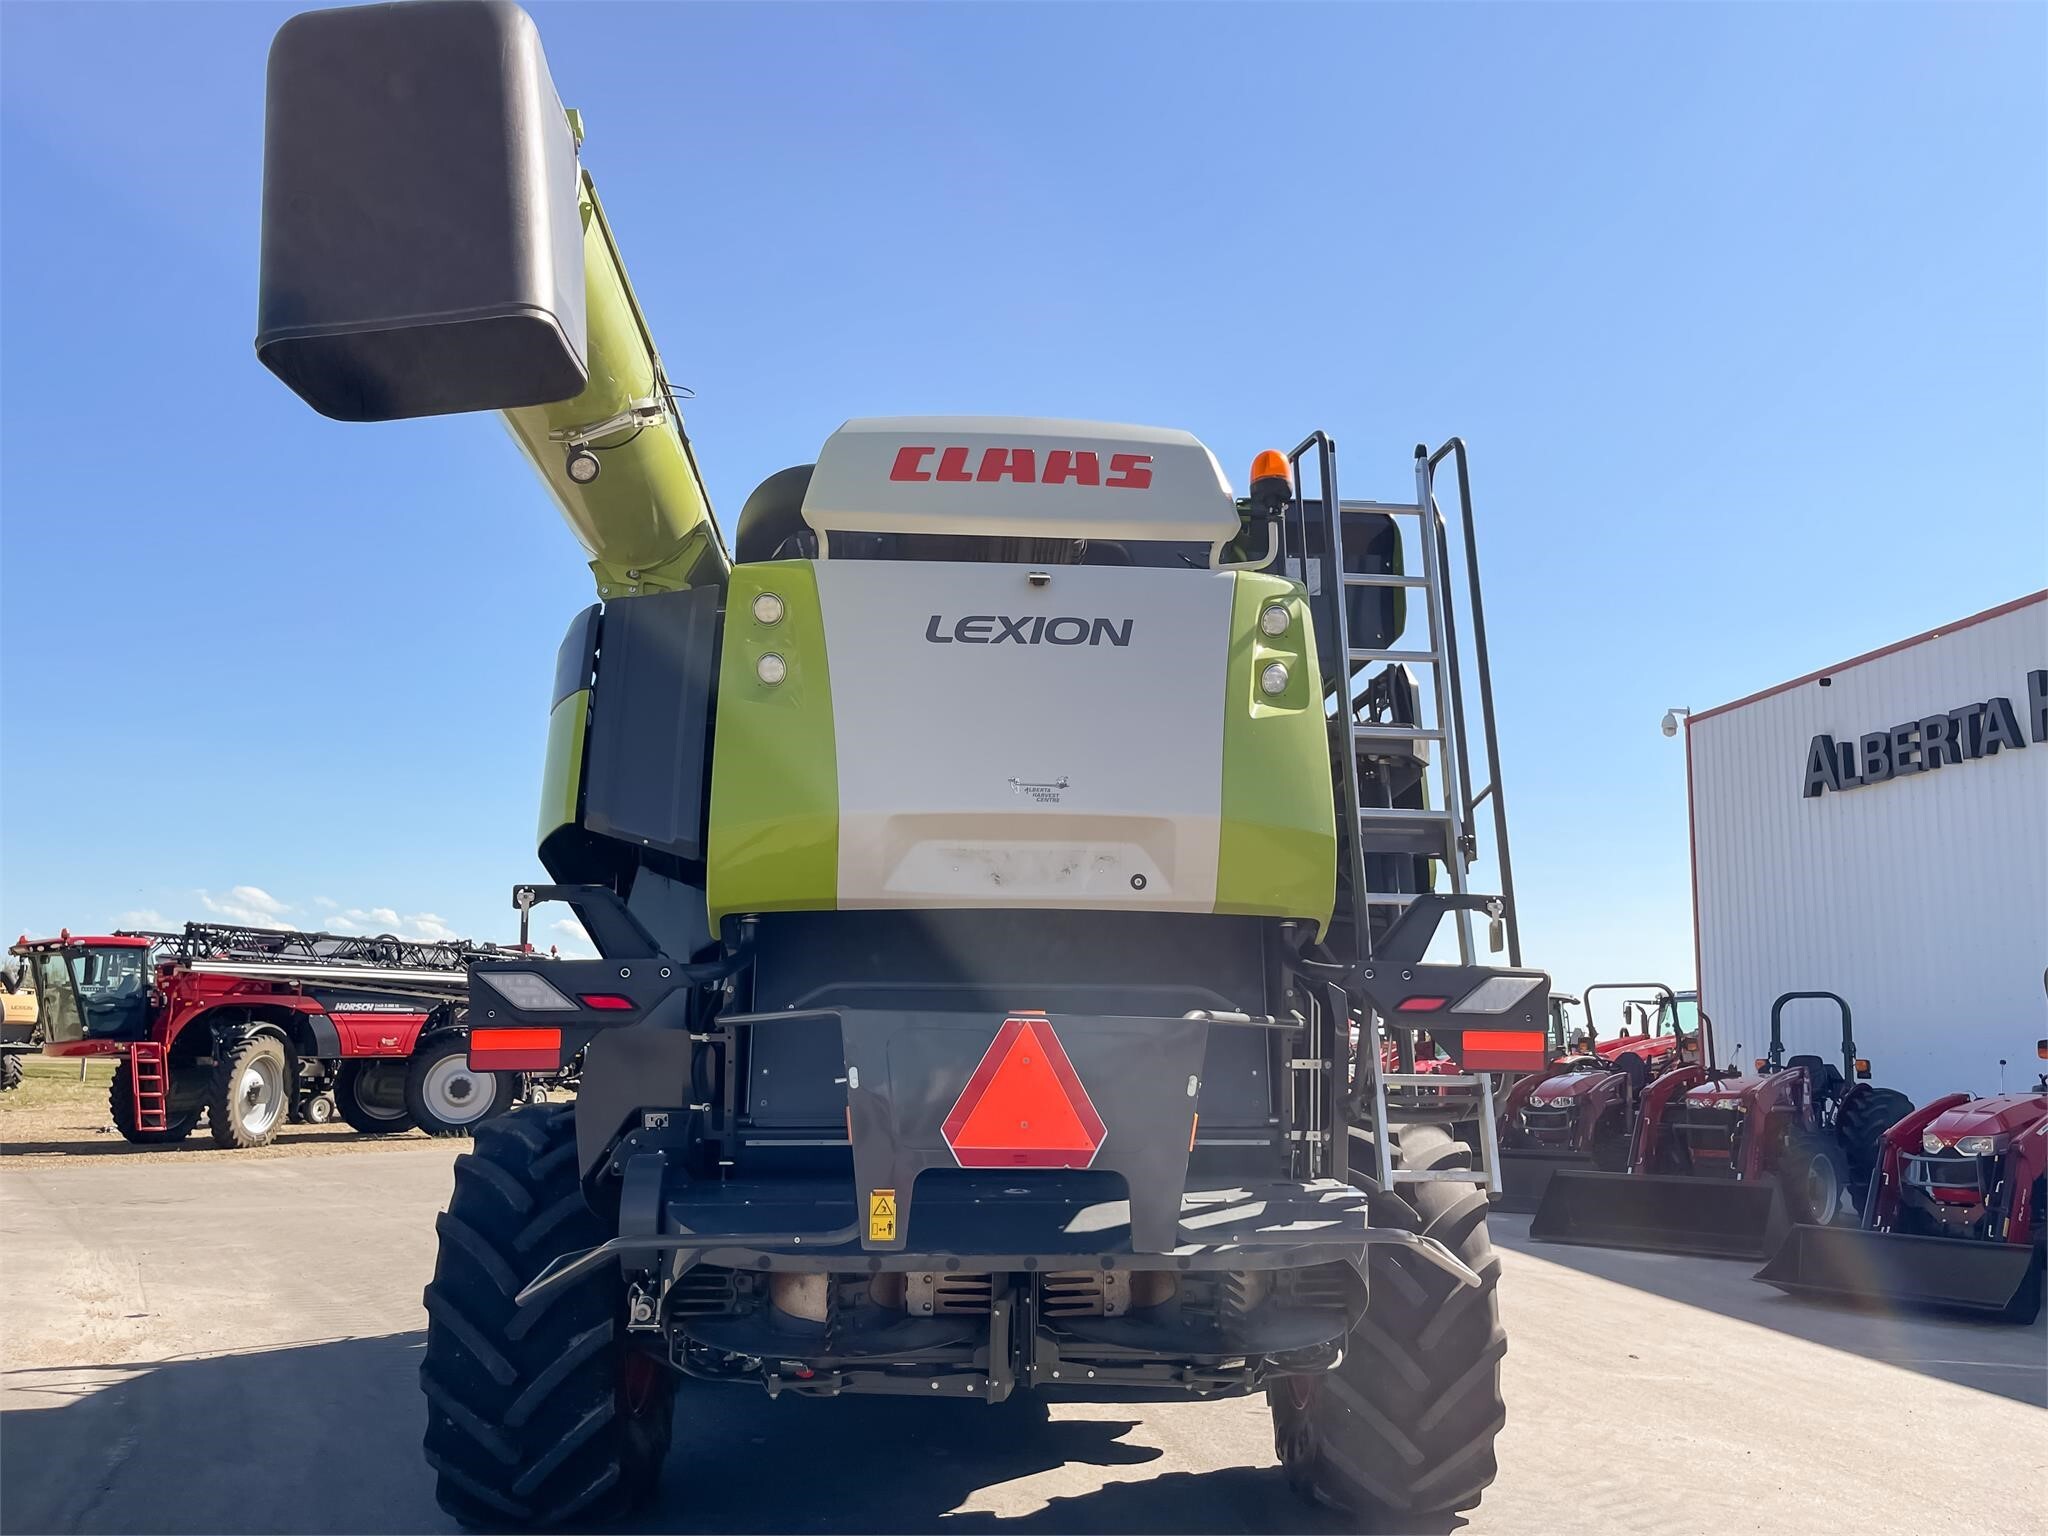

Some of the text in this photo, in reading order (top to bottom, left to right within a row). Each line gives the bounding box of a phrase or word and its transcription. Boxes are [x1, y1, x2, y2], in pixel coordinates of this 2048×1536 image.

[889, 446, 1153, 489] CLAAS
[925, 615, 1134, 647] LEXION
[1803, 697, 2026, 798] ALBERTA
[334, 1003, 374, 1011] HORSCH
